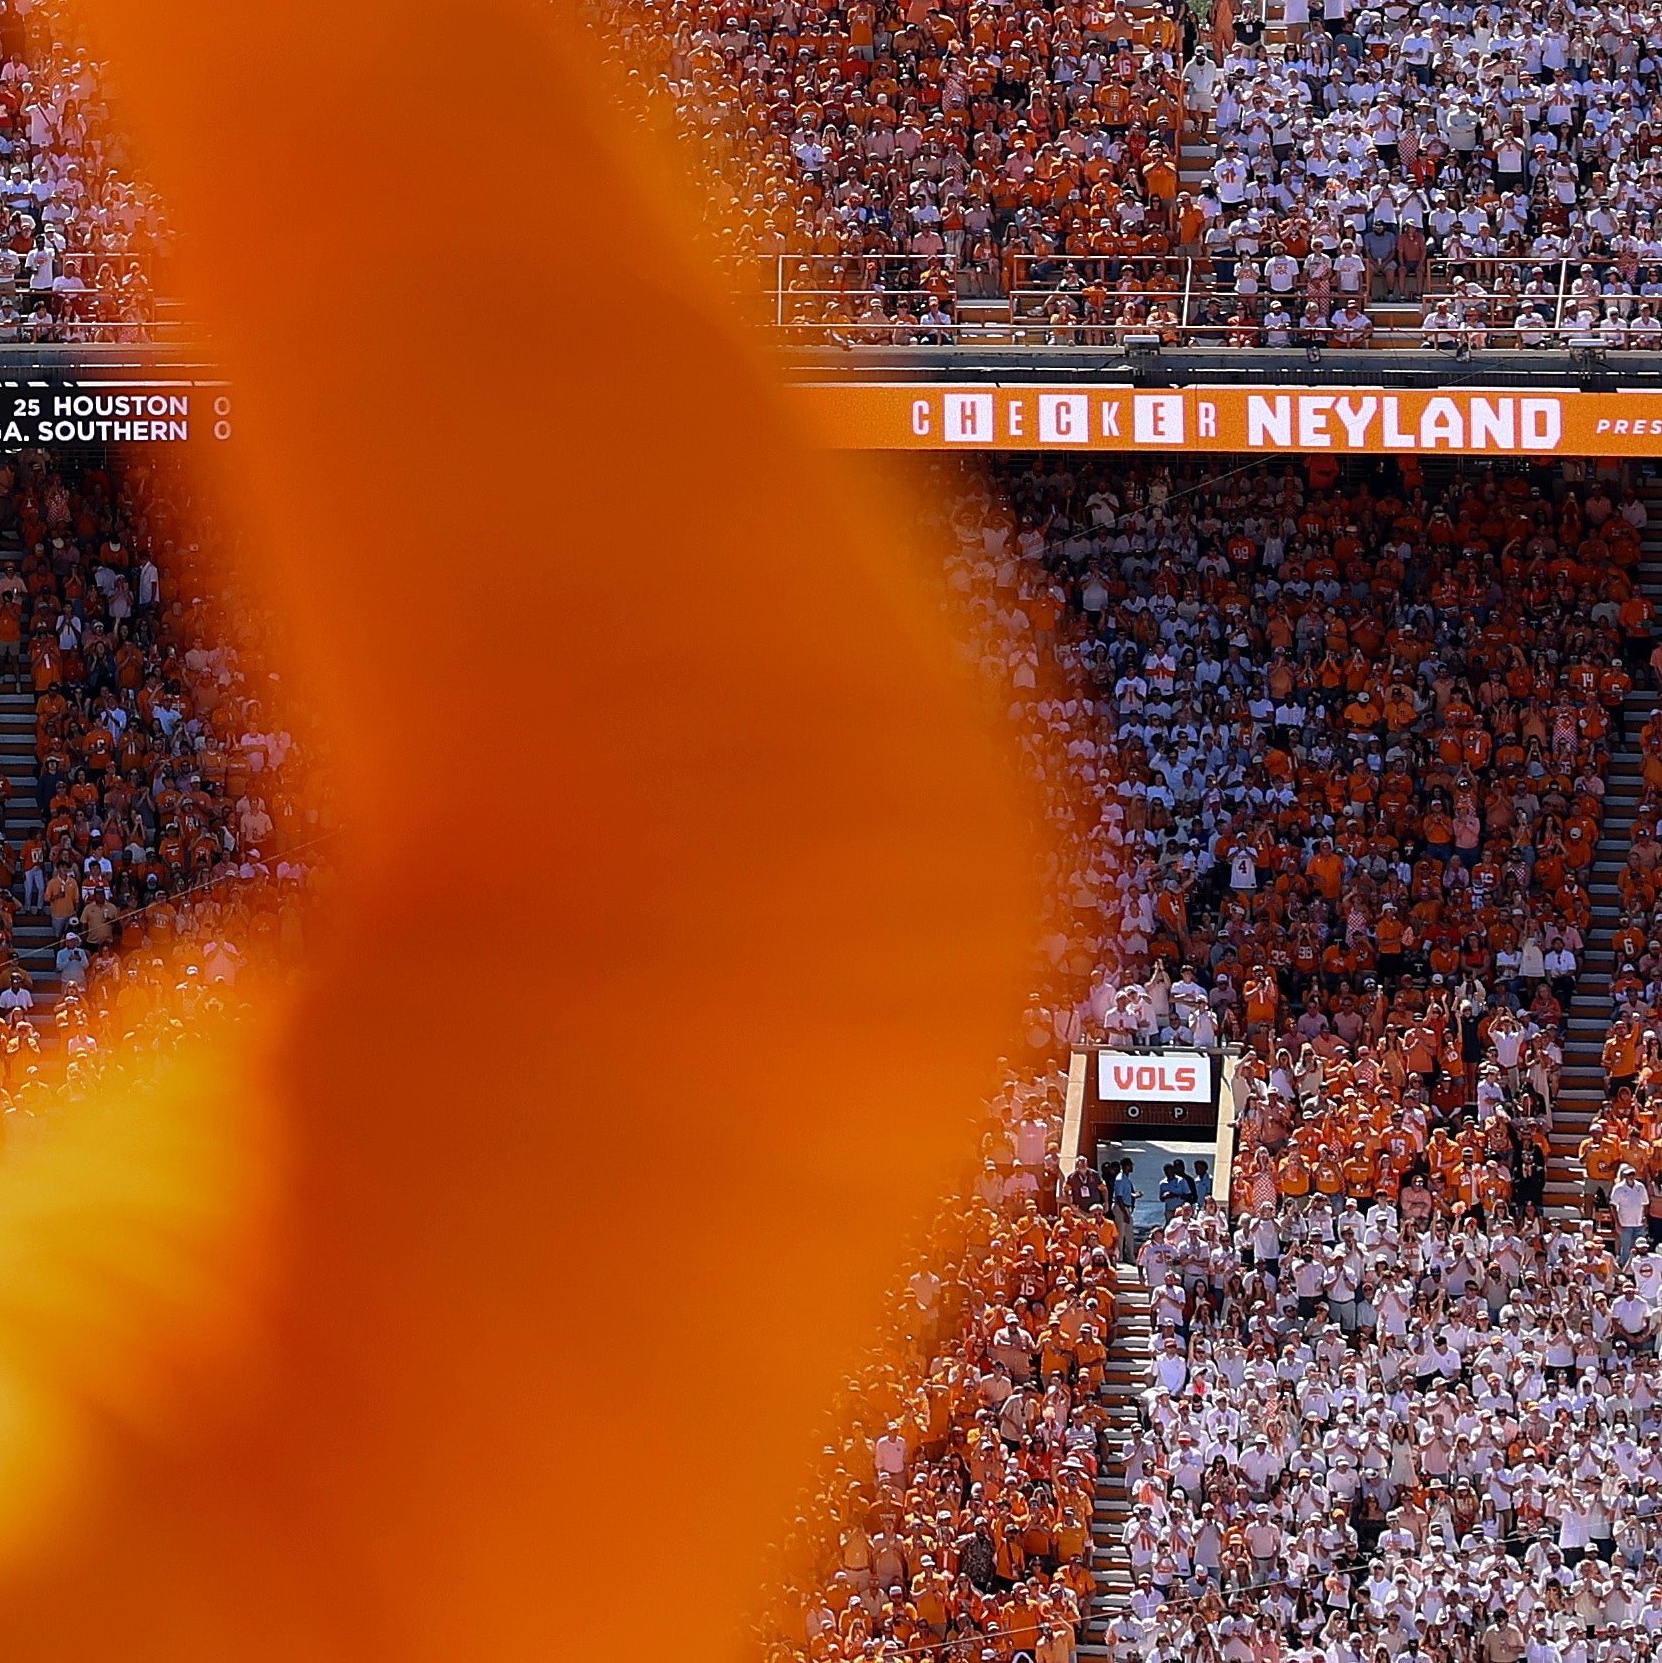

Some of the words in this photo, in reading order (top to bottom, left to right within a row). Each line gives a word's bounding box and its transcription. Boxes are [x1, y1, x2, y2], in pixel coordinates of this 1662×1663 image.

[13, 399, 41, 416] 25
[54, 396, 188, 416] HOUSTON
[912, 400, 1218, 438] CHECKER
[1247, 394, 1563, 450] NEYLAND
[1596, 419, 1662, 434] PRES
[38, 421, 188, 441] SOUTHERN
[1582, 673, 1594, 686] 14
[1238, 861, 1247, 874] 4
[1624, 938, 1634, 954] 6
[1113, 1066, 1195, 1091] VOLS
[1128, 1106, 1139, 1117] O
[1175, 1107, 1184, 1117] P
[1020, 1280, 1034, 1295] 16
